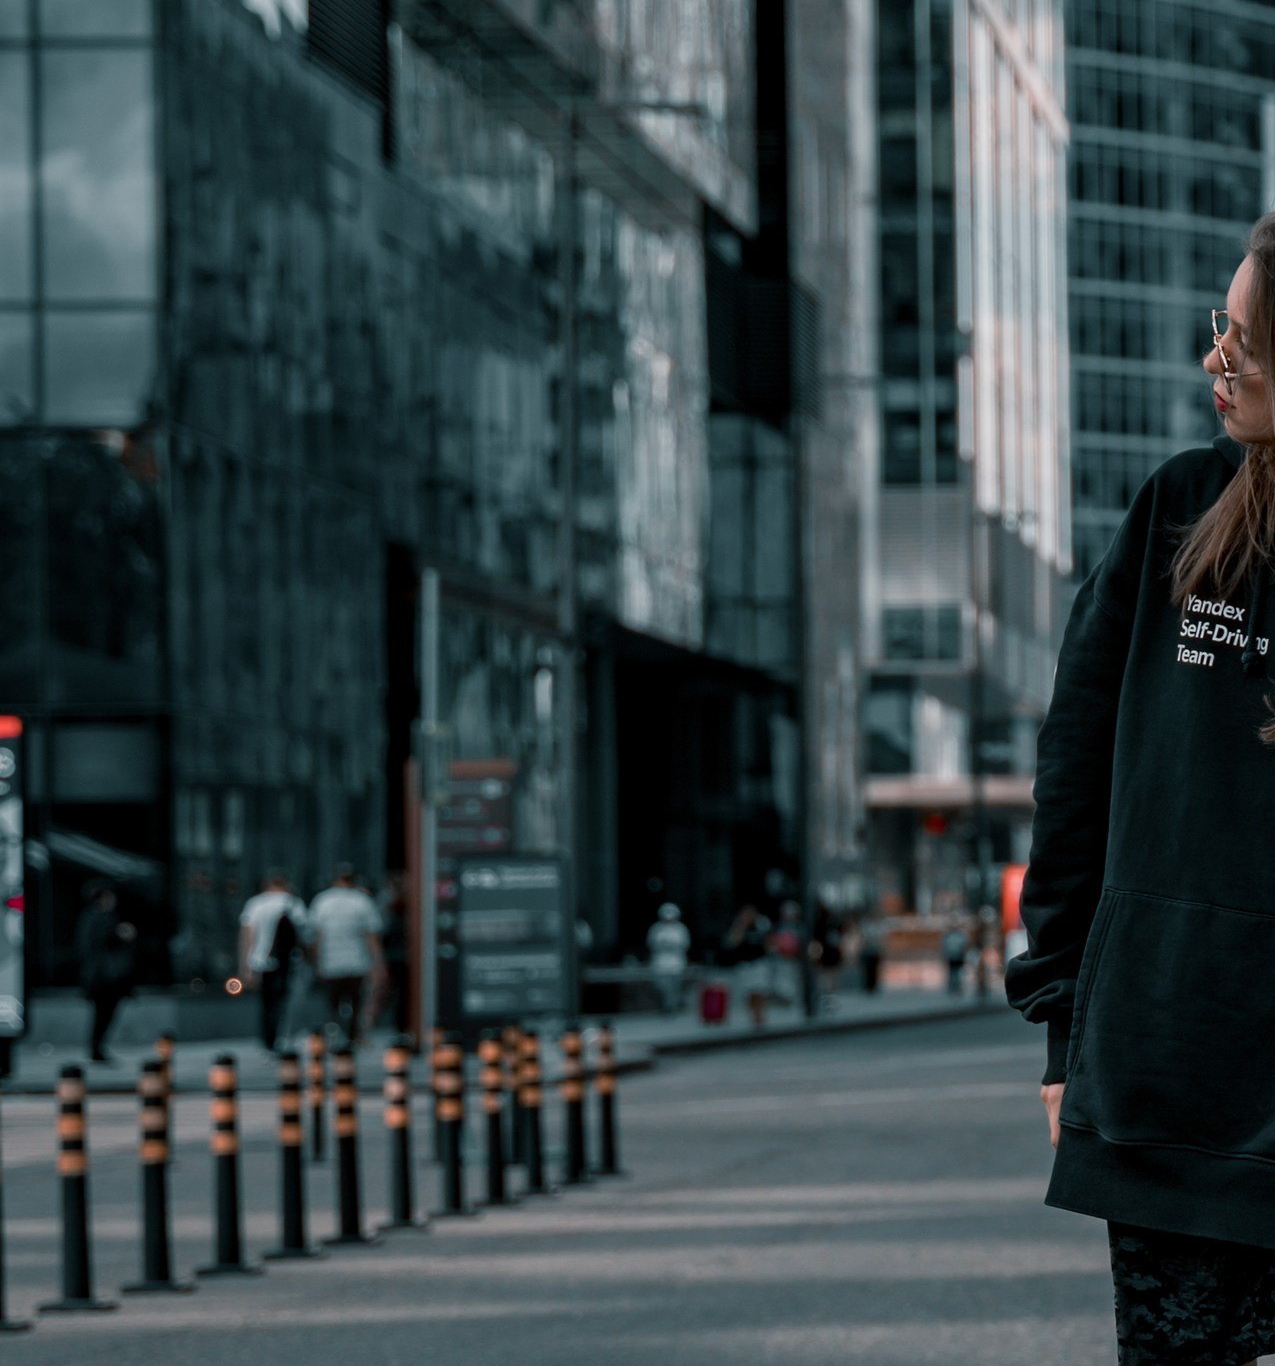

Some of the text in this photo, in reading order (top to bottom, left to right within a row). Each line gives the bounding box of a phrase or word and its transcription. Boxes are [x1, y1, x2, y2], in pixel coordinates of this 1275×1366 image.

[1187, 593, 1246, 622] Yandex
[1180, 618, 1269, 655] Self-Drivng
[1176, 644, 1215, 667] Team
